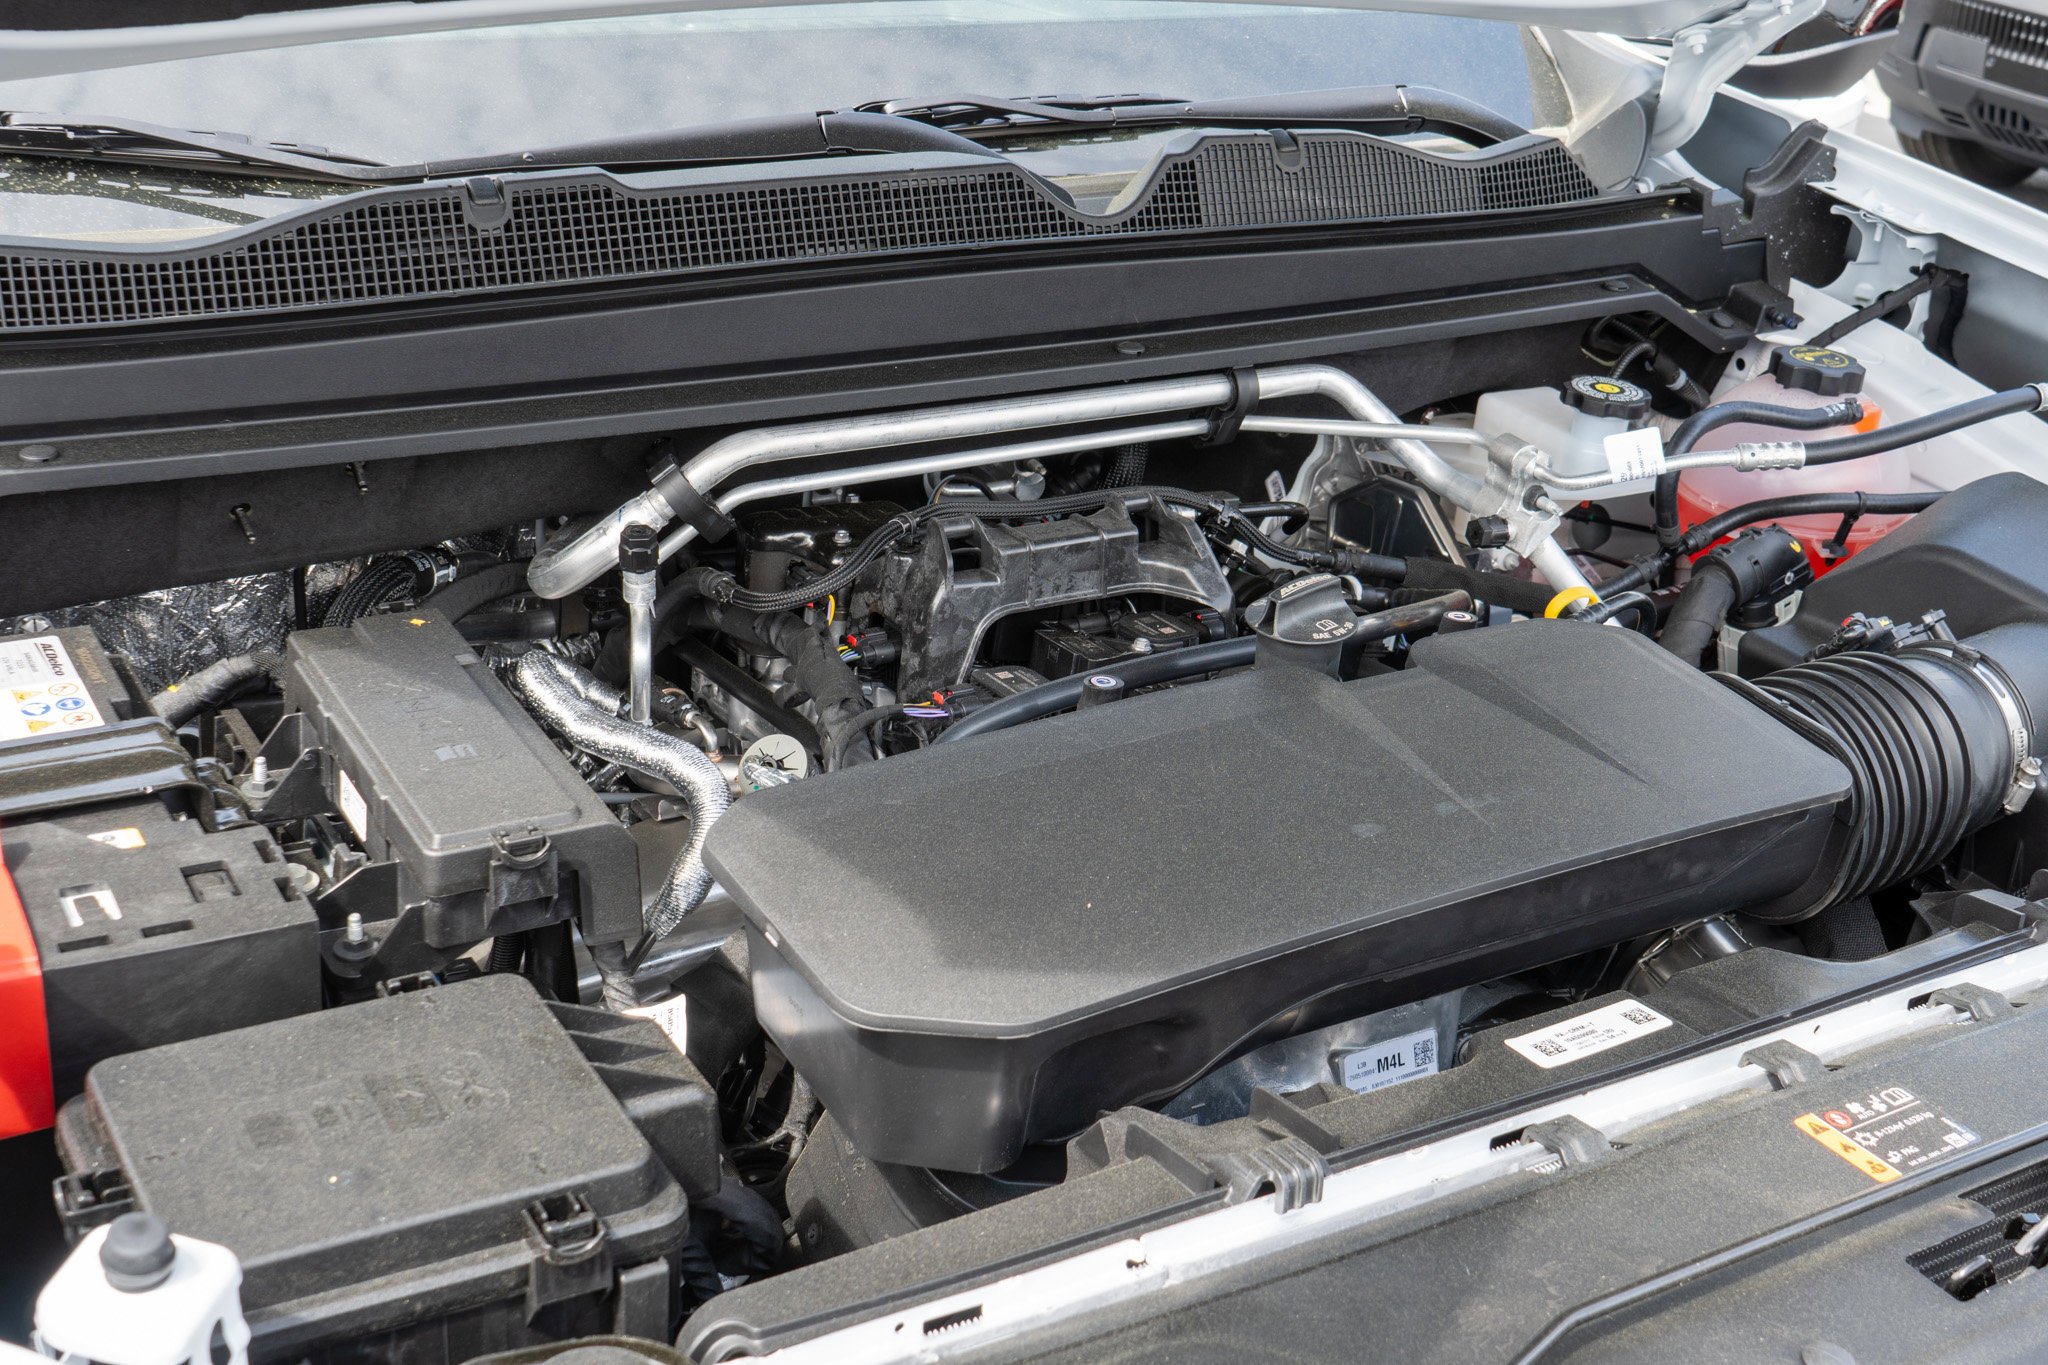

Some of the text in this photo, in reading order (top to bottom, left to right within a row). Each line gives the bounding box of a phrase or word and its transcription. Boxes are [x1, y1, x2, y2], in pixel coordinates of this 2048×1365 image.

[1312, 632, 1332, 640] SAE
[40, 643, 65, 676] ACDelco
[1377, 1052, 1405, 1074] M4L
